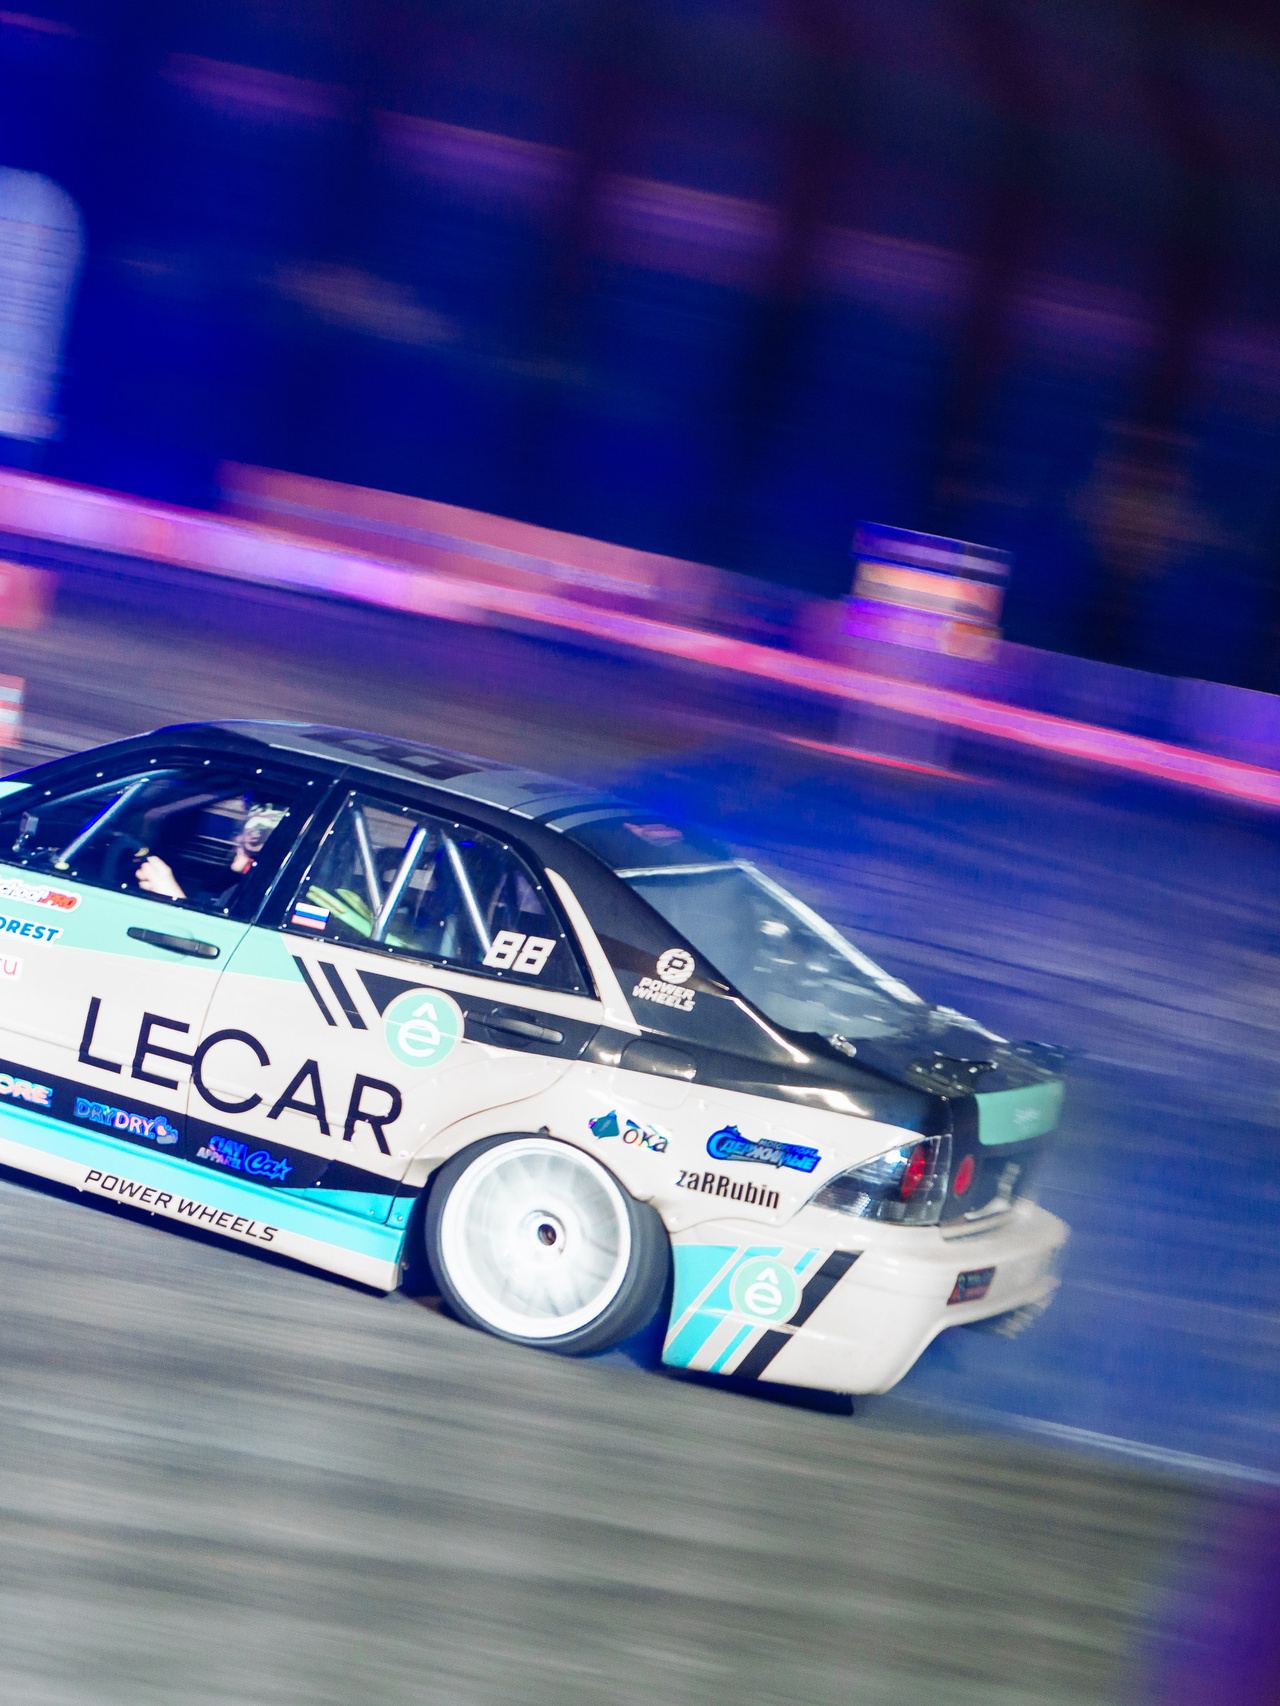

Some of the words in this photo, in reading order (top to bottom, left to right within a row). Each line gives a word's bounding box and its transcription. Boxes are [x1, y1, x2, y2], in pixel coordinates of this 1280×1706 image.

[482, 930, 557, 975] 88
[632, 985, 696, 1012] WHEELS
[639, 977, 696, 1001] POWER
[78, 996, 403, 1156] LECAR
[84, 1169, 174, 1209] POWER
[176, 1198, 279, 1242] WHEELS
[675, 1169, 781, 1210] zaRRubin
